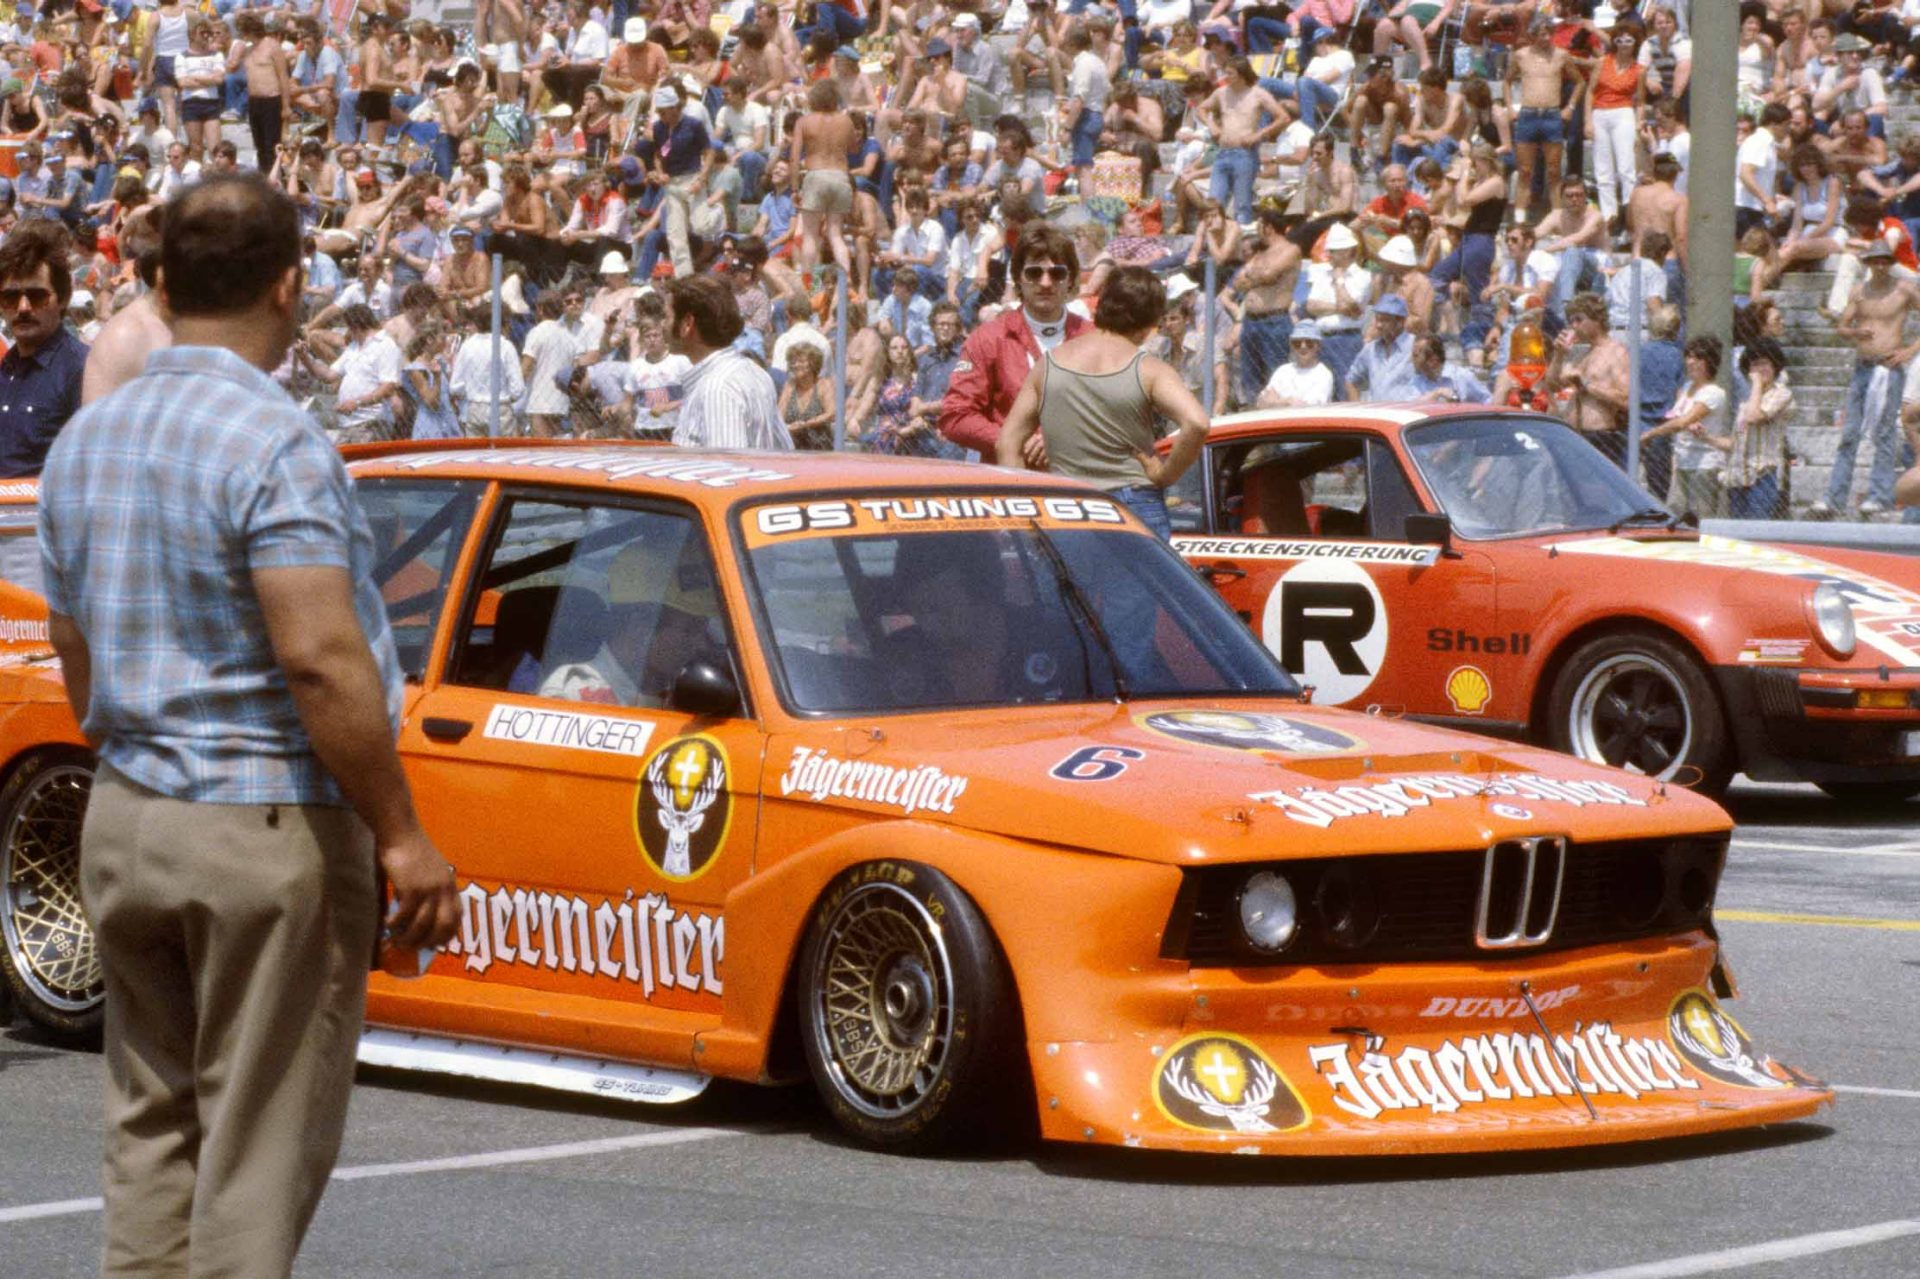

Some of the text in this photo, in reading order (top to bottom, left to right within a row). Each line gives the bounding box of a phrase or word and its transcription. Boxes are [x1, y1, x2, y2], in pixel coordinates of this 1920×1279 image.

[757, 501, 854, 534] GS
[860, 497, 1038, 523] TUNING
[1044, 498, 1122, 525] GS
[1174, 540, 1430, 561] STRECKENSICHERUNG
[1281, 581, 1372, 675] R
[1426, 628, 1531, 656] Shell
[1048, 745, 1145, 782] 6
[436, 881, 724, 999] germeister
